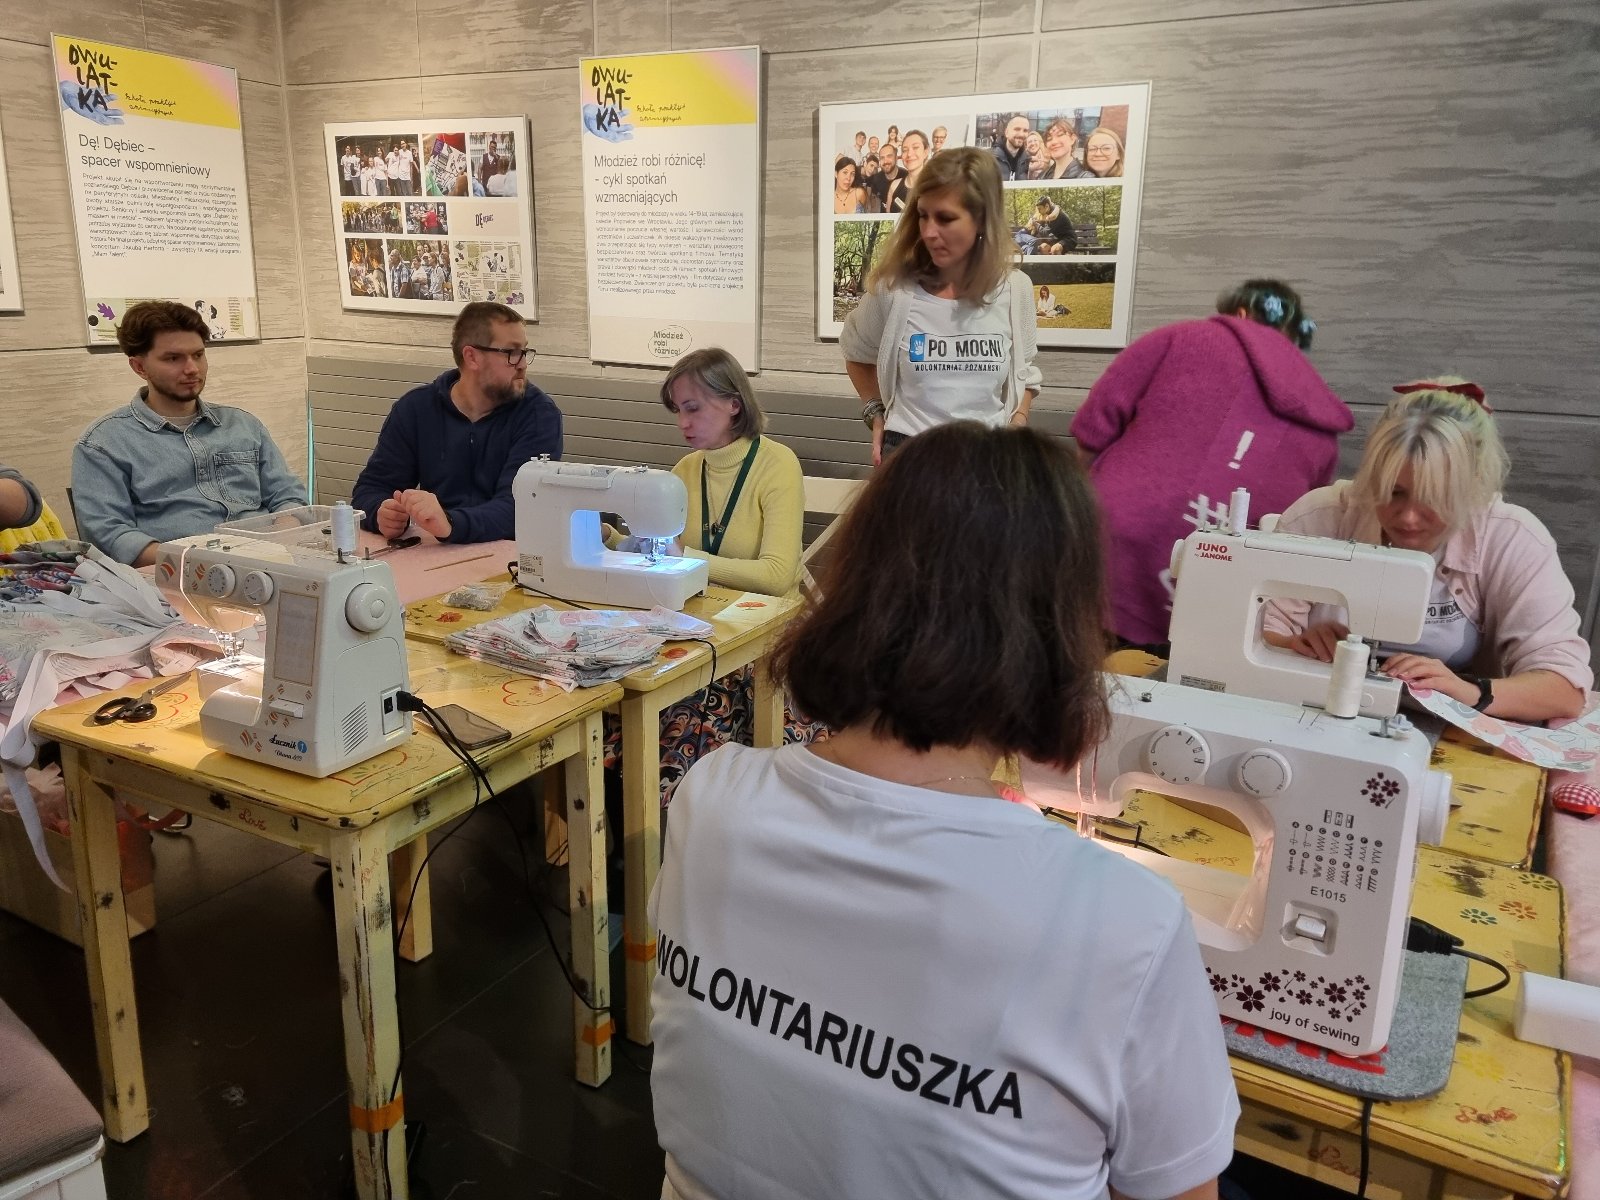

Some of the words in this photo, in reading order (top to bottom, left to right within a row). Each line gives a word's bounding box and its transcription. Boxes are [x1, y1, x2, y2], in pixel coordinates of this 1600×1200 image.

[79, 134, 100, 150] Dę!
[104, 136, 145, 153] Dębiec
[81, 155, 121, 168] spacer
[125, 158, 211, 178] wspomnieniowy
[594, 155, 638, 167] Młodzież
[641, 154, 661, 166] robi
[664, 153, 706, 168] różnicę!
[603, 173, 623, 187] cykl
[626, 172, 667, 187] spotkań
[595, 190, 678, 205] wzmacniających
[928, 339, 947, 358] PO
[956, 339, 1002, 358] MOCNI
[914, 364, 962, 372] WOLONTARIAT
[1196, 542, 1228, 554] JUNO
[1200, 553, 1232, 562] JANOME
[1310, 886, 1346, 902] E1015
[657, 929, 1022, 1119] WOLONTARIUSZKA
[1269, 1008, 1290, 1024] joy
[1295, 1018, 1309, 1028] of
[1312, 1022, 1360, 1046] sewing
